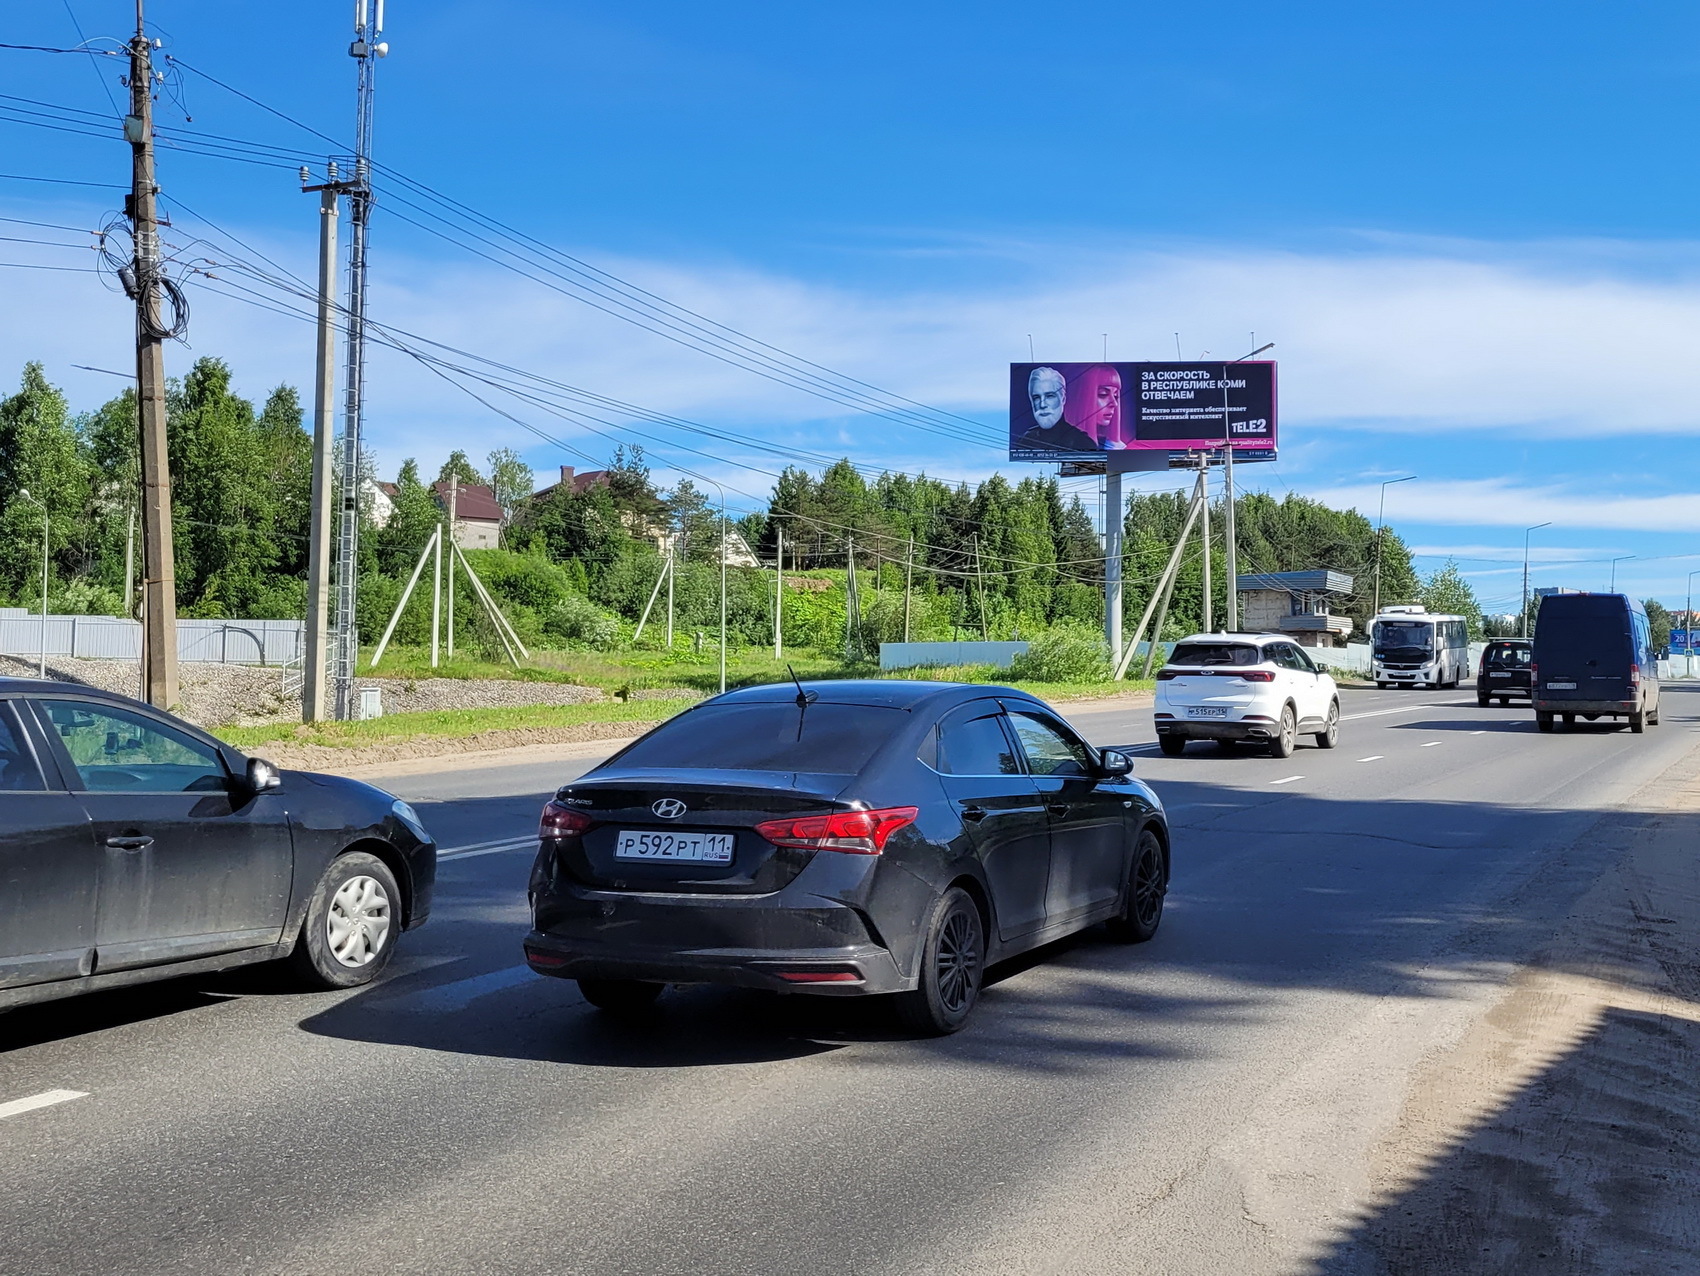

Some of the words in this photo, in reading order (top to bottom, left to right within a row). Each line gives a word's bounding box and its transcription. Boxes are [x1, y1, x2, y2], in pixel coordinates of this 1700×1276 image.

[1141, 371, 1156, 380] ЗА
[1157, 370, 1210, 380] СКОРОСТЬ
[1141, 381, 1149, 390] В
[1150, 380, 1216, 390] РЕСПУБЛИКЕ
[1217, 379, 1246, 389] КОМИ
[1141, 391, 1195, 400] ОТВЕЧАЕМ
[1171, 406, 1204, 415] интернета
[1141, 413, 1189, 421] искусственный
[1231, 418, 1267, 433] TELE2
[624, 834, 701, 858] Р592РТ
[703, 851, 719, 859] RUS
